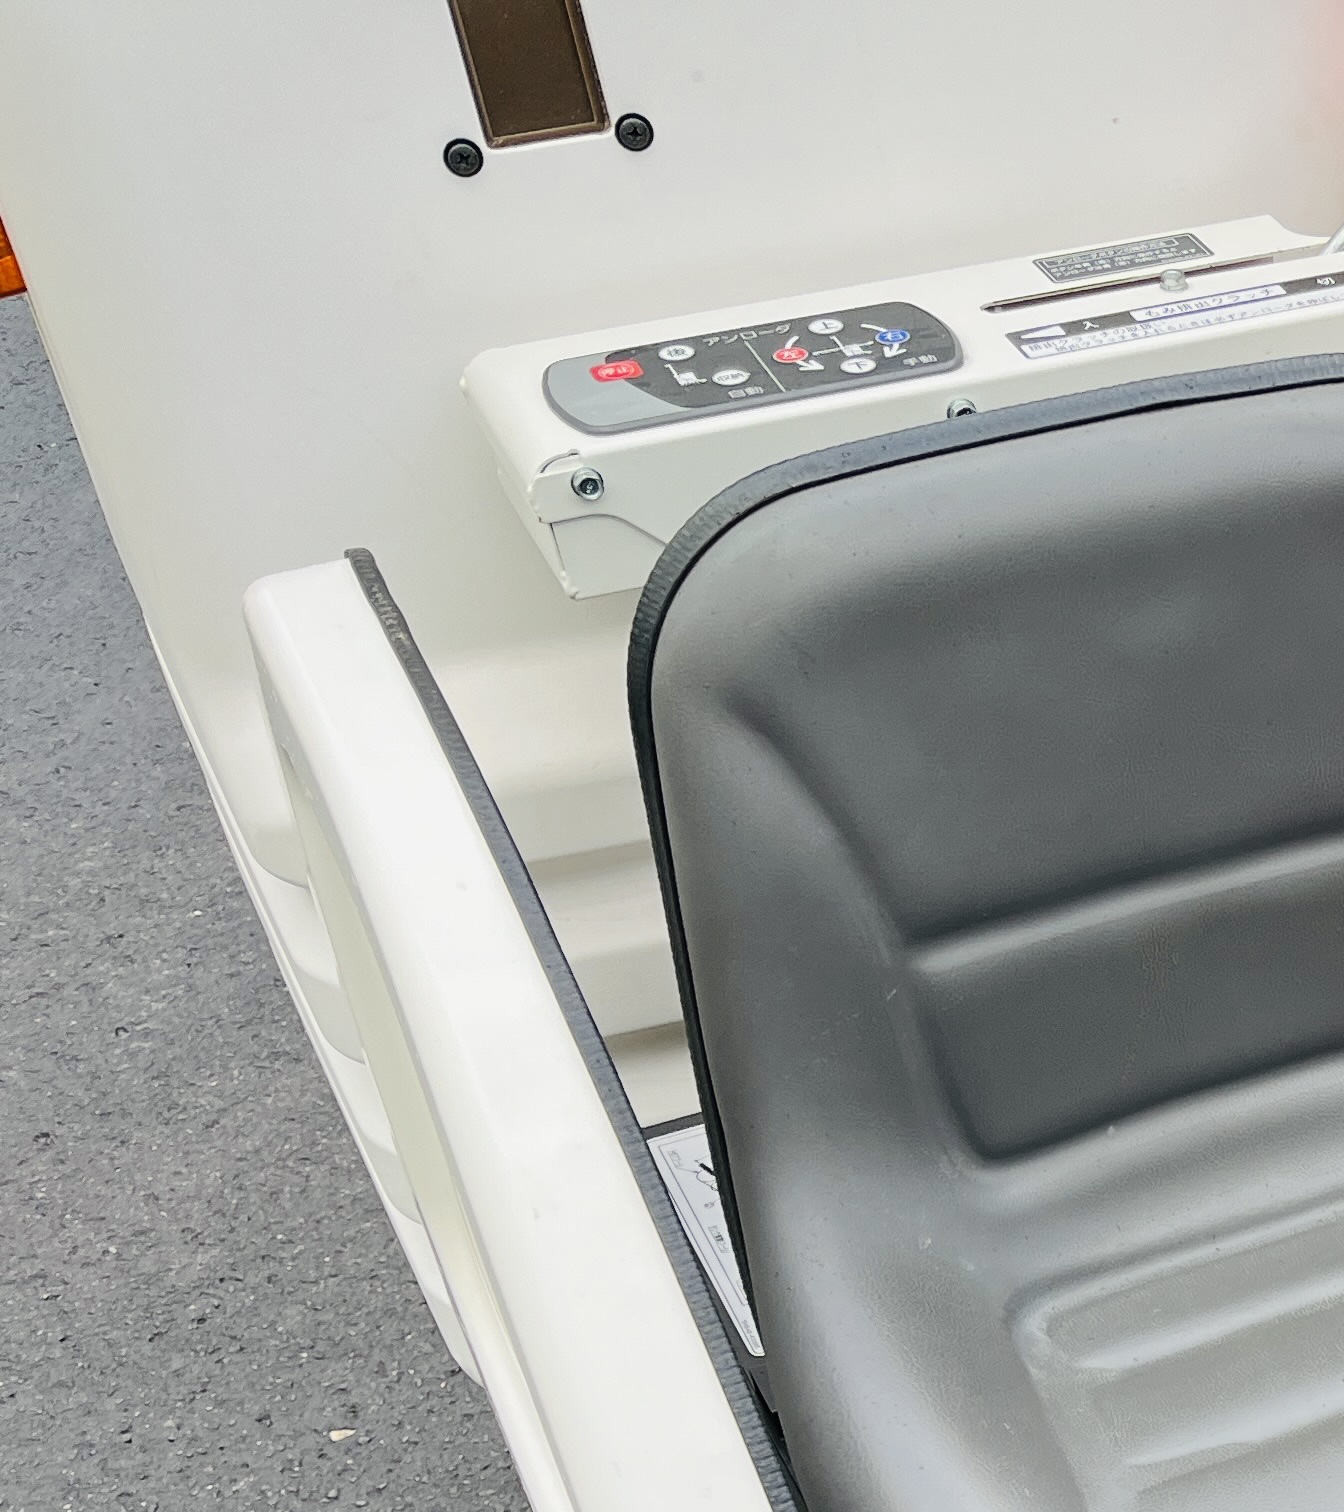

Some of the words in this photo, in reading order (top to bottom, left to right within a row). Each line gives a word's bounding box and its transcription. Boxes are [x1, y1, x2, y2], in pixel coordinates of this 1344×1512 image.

[817, 320, 836, 332] 上
[1083, 319, 1099, 331] 入
[702, 323, 791, 346] アンローダ
[884, 329, 904, 343] 右
[782, 347, 800, 362] 左
[848, 360, 868, 372] 下
